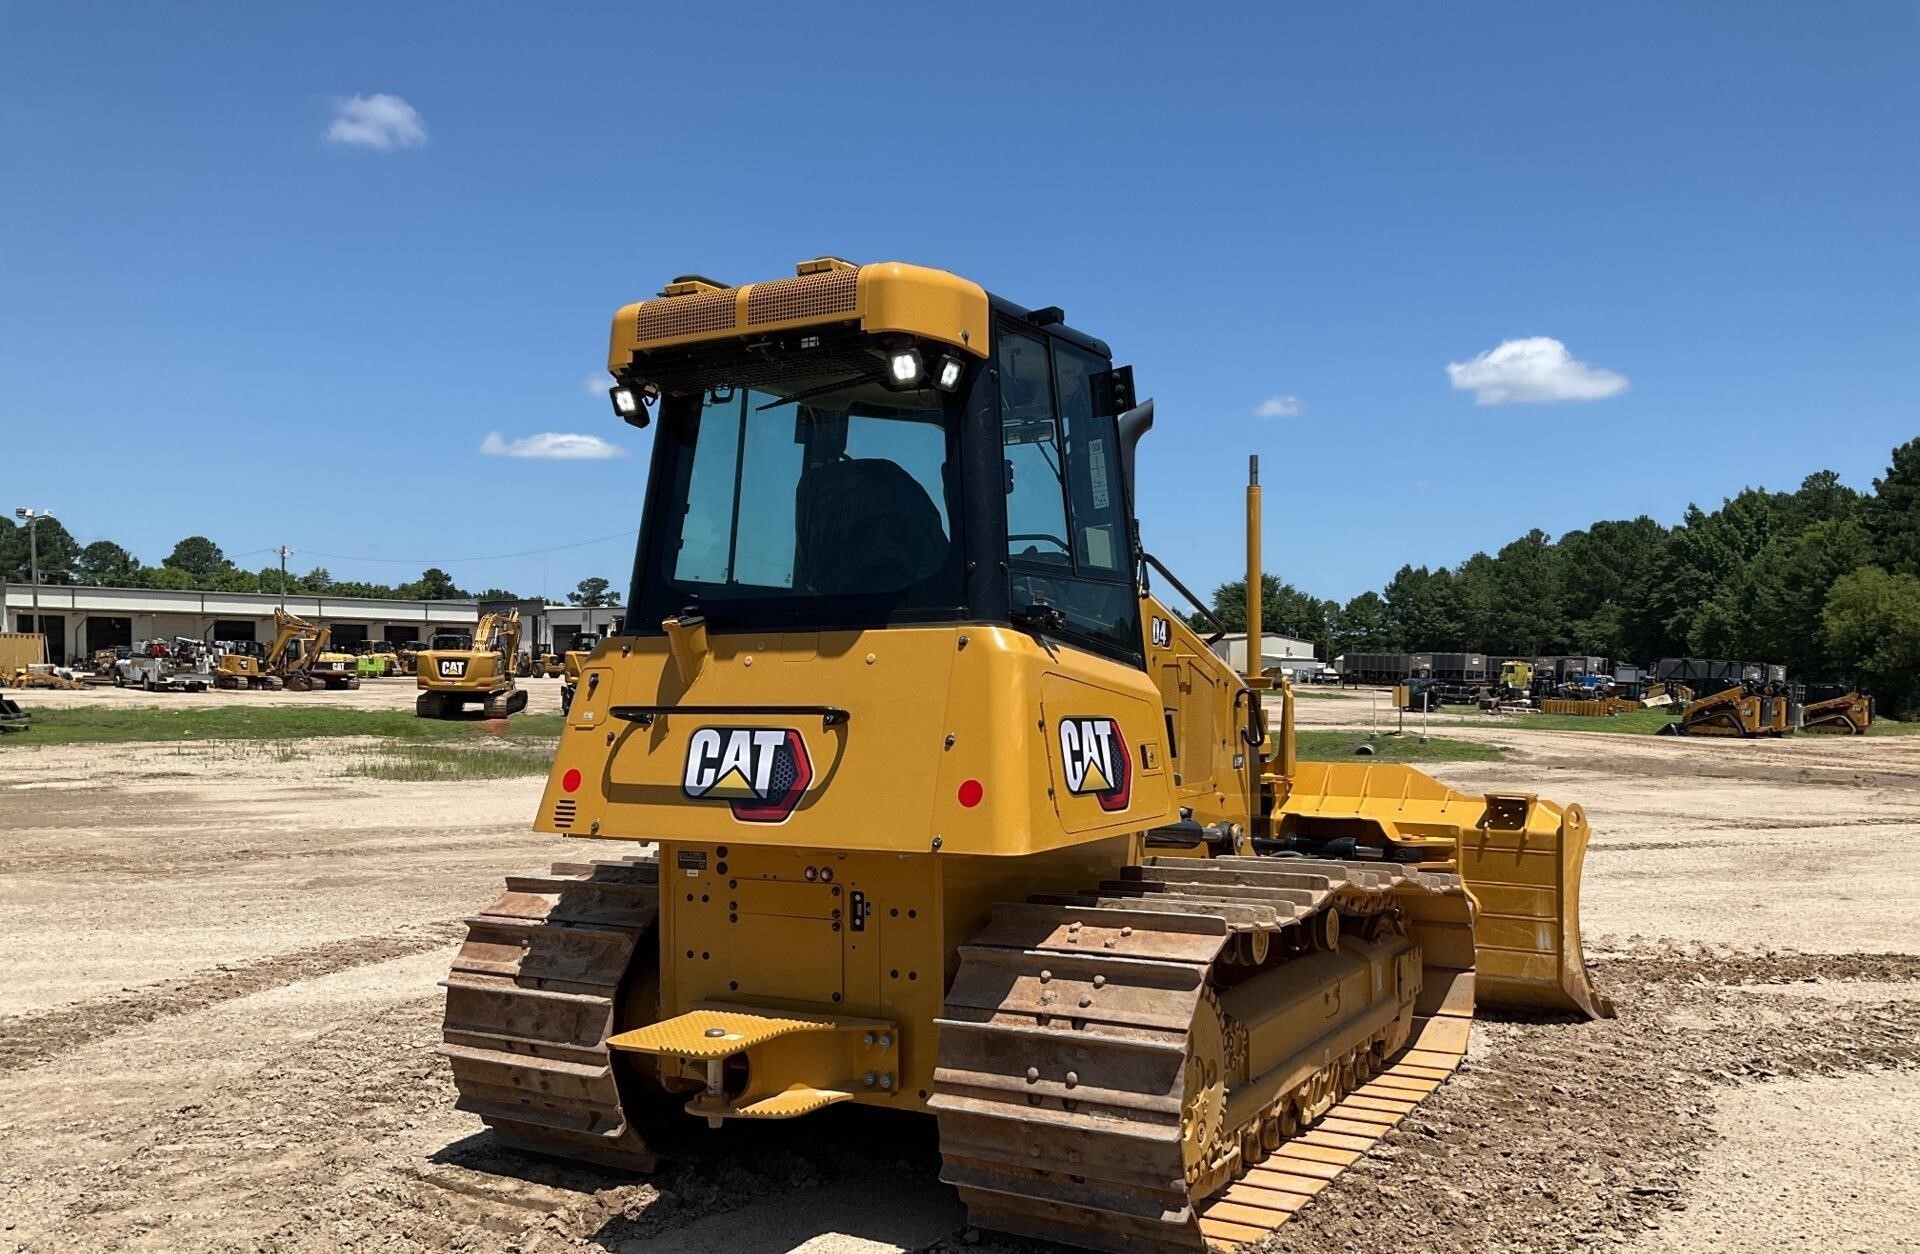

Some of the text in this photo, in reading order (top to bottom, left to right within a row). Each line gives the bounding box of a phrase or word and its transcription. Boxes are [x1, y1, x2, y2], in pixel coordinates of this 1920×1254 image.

[1152, 617, 1167, 646] D4
[332, 662, 346, 671] CAT
[441, 661, 465, 675] CAT
[684, 729, 786, 799] CAT
[1060, 719, 1115, 792] CAT
